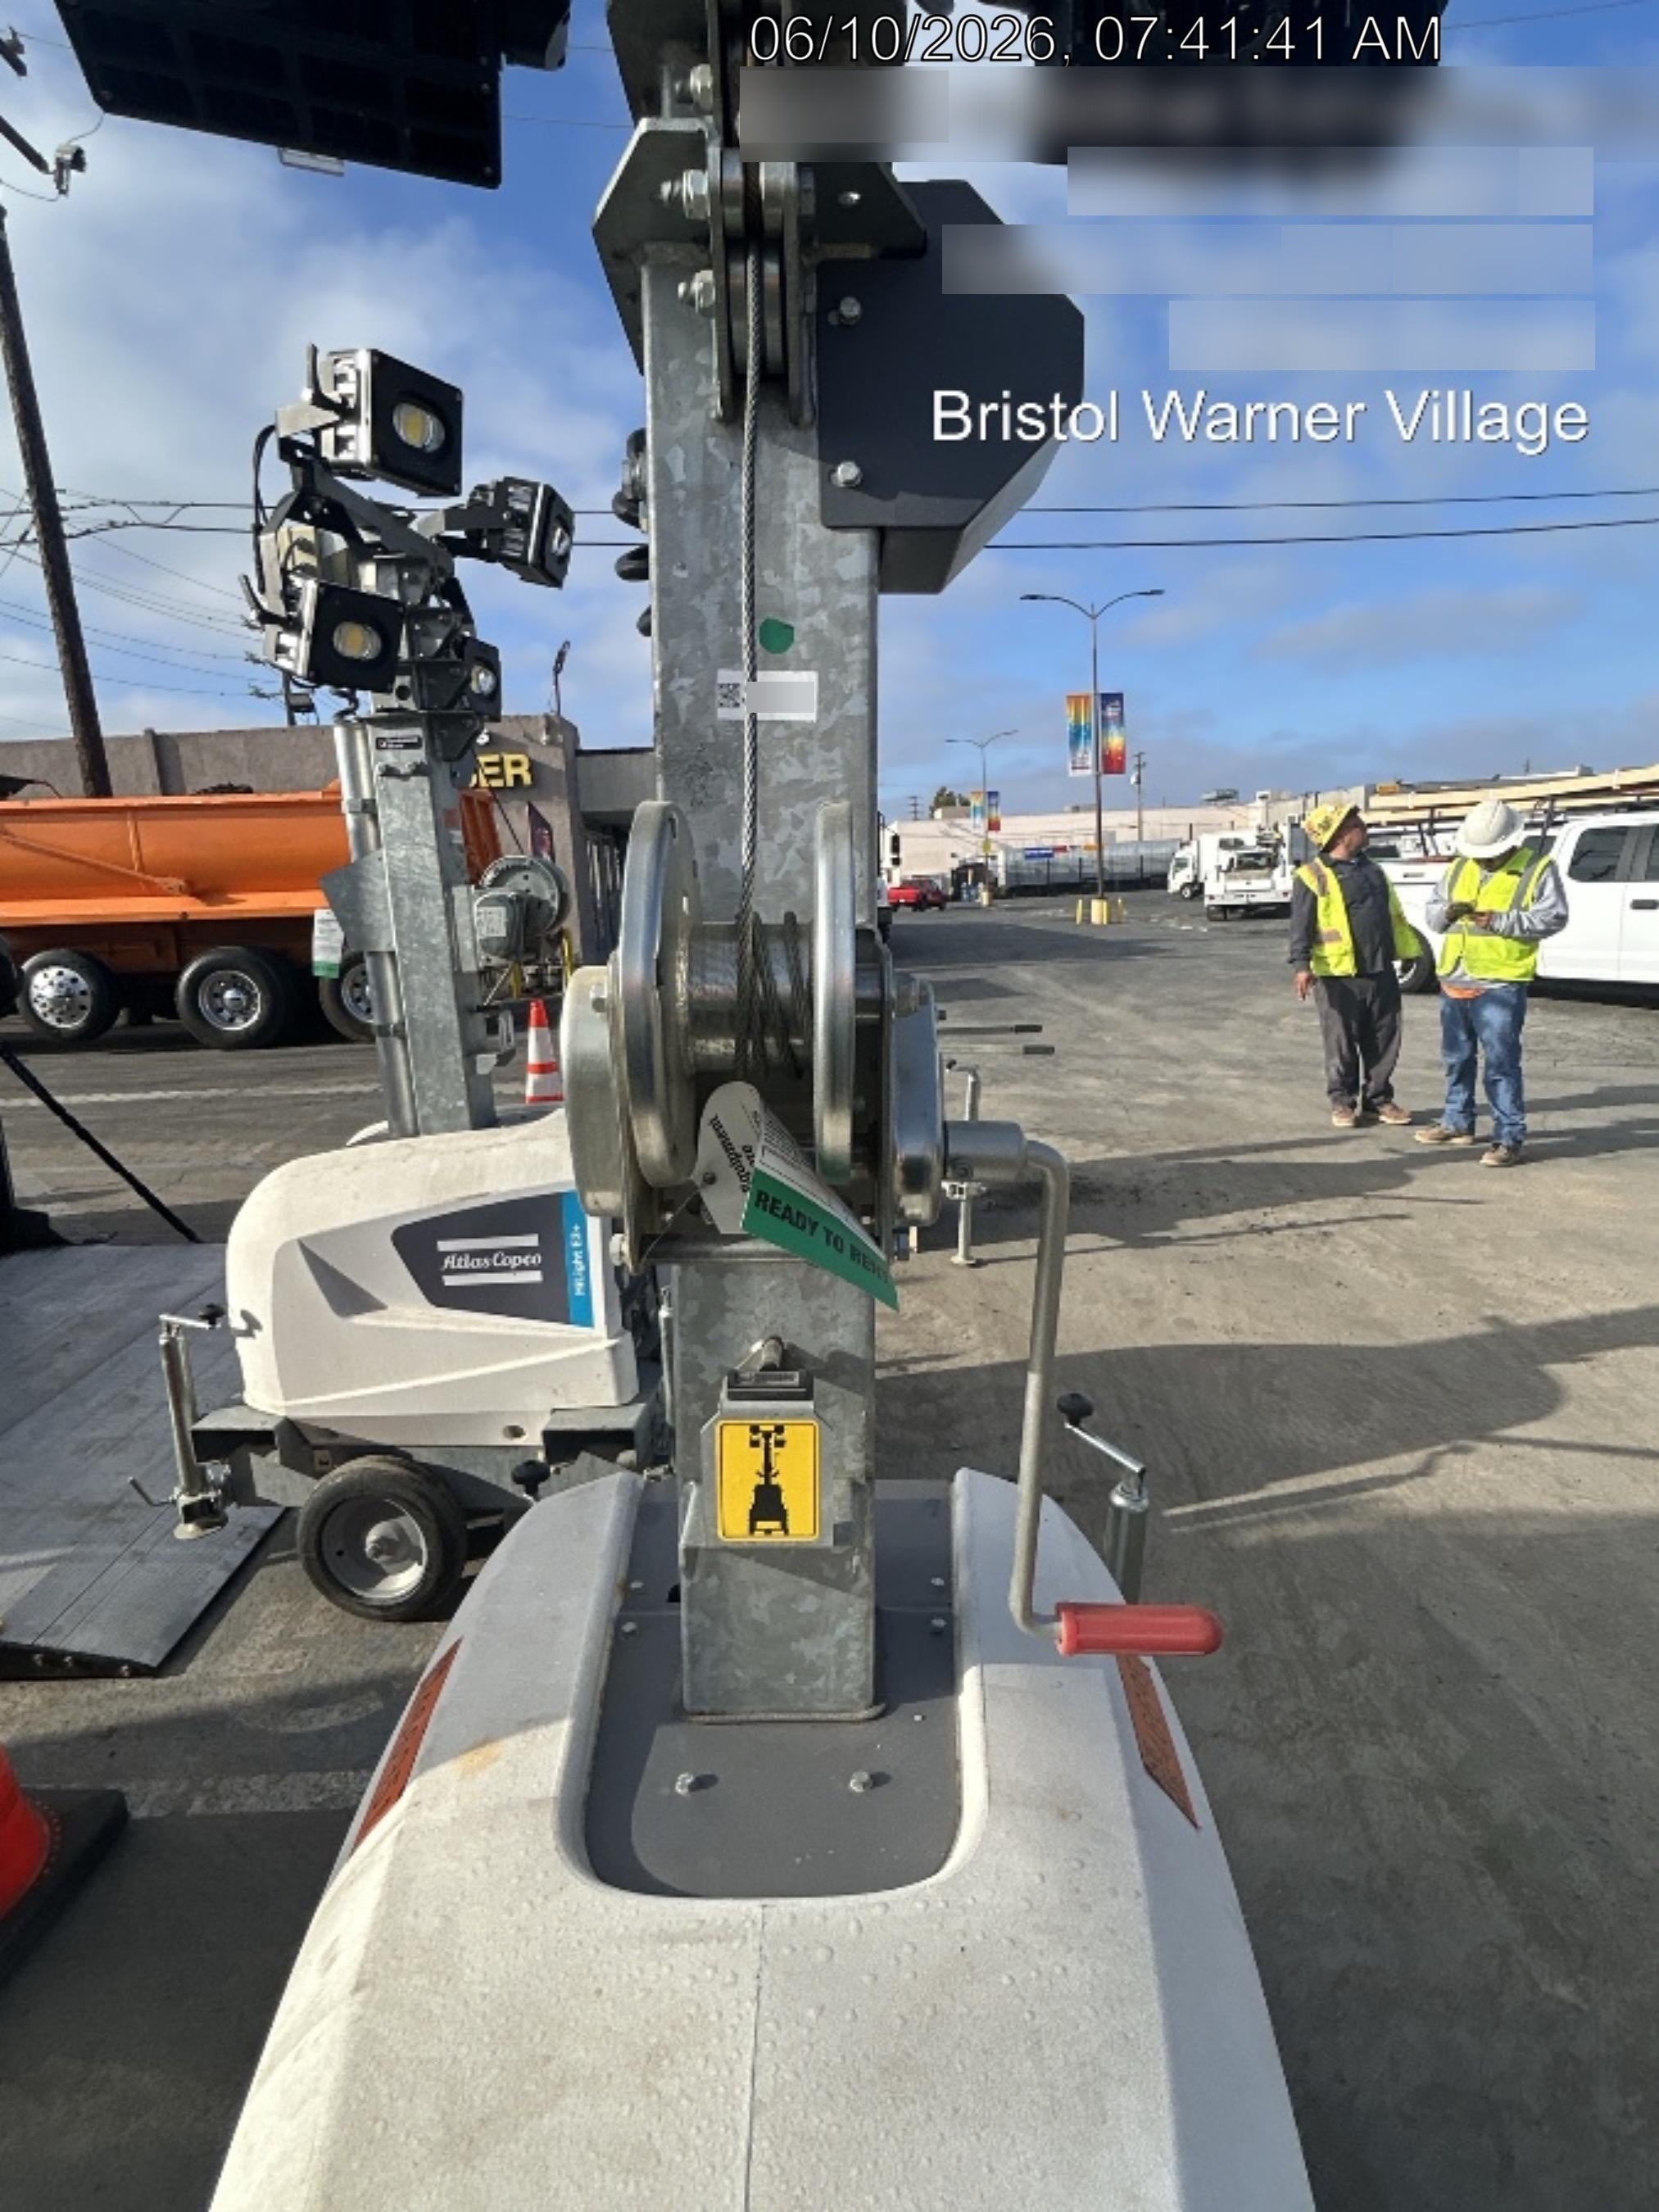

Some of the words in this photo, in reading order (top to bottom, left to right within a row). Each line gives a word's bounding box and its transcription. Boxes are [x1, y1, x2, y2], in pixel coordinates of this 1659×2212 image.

[469, 753, 532, 788] ER
[755, 1188, 818, 1237] READY
[823, 1226, 844, 1254] TO
[441, 1253, 490, 1271] Atlas
[492, 1250, 542, 1269] Copco
